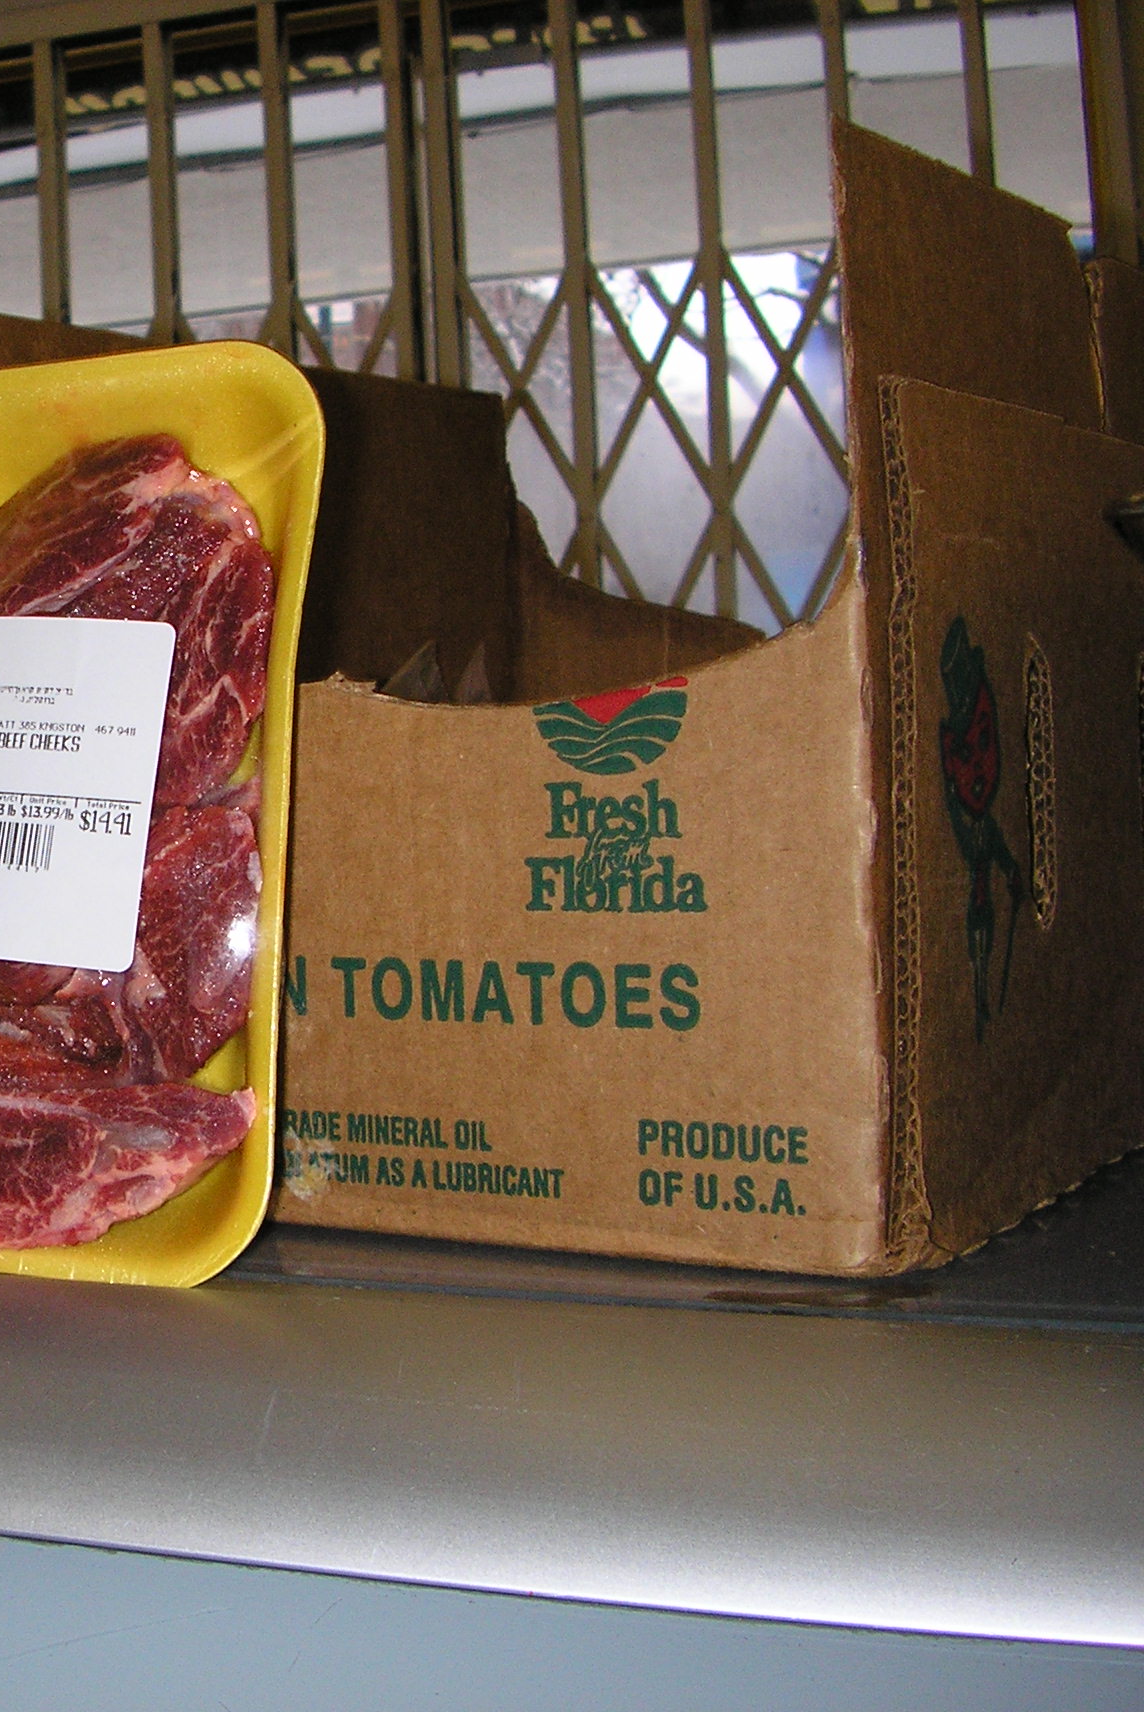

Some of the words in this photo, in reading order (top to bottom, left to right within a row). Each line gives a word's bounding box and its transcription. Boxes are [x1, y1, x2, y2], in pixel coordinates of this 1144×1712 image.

[29, 733, 81, 753] CHEEKS
[95, 725, 114, 735] 467
[7, 804, 17, 817] lb
[21, 805, 74, 821] $13.99/lb
[46, 798, 67, 806] Price
[87, 801, 107, 809] Total
[108, 803, 130, 811] Price
[544, 779, 683, 839] Fresh
[78, 809, 132, 836] $14.41
[524, 855, 709, 914] Florida
[330, 955, 702, 1033] TOMATOES
[283, 1109, 341, 1142] RADE
[347, 1112, 448, 1149] MINERAL
[454, 1119, 493, 1152] OIL
[638, 1118, 809, 1164] PRODUCE
[376, 1156, 405, 1187] AS
[411, 1159, 427, 1189] A
[432, 1159, 565, 1199] LUBRICANT
[638, 1168, 684, 1207] OF
[694, 1172, 807, 1217] U.S.A.
